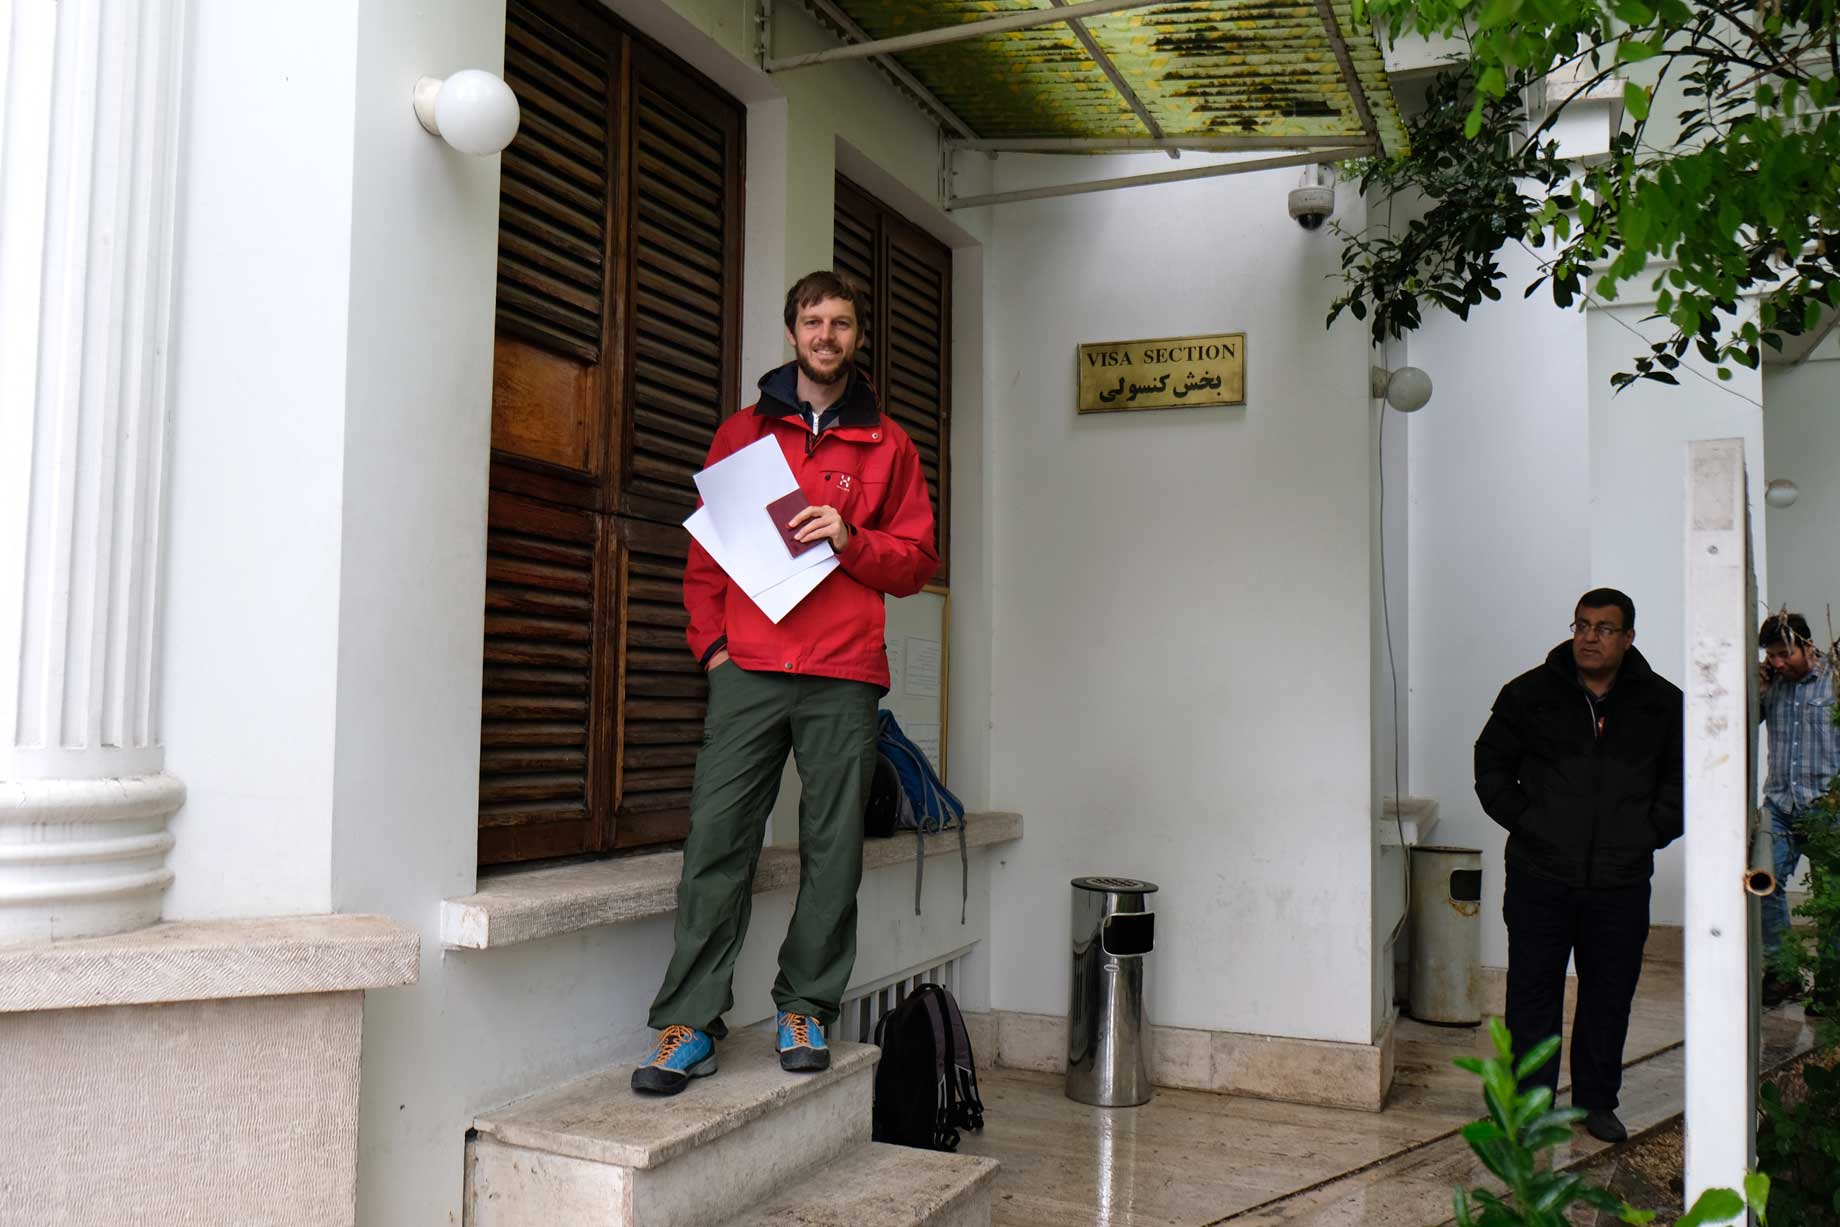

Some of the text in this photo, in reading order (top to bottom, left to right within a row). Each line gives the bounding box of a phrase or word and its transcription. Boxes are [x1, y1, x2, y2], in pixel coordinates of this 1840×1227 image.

[1087, 343, 1235, 367] VISA SECTION
[1173, 370, 1222, 398] بخش
